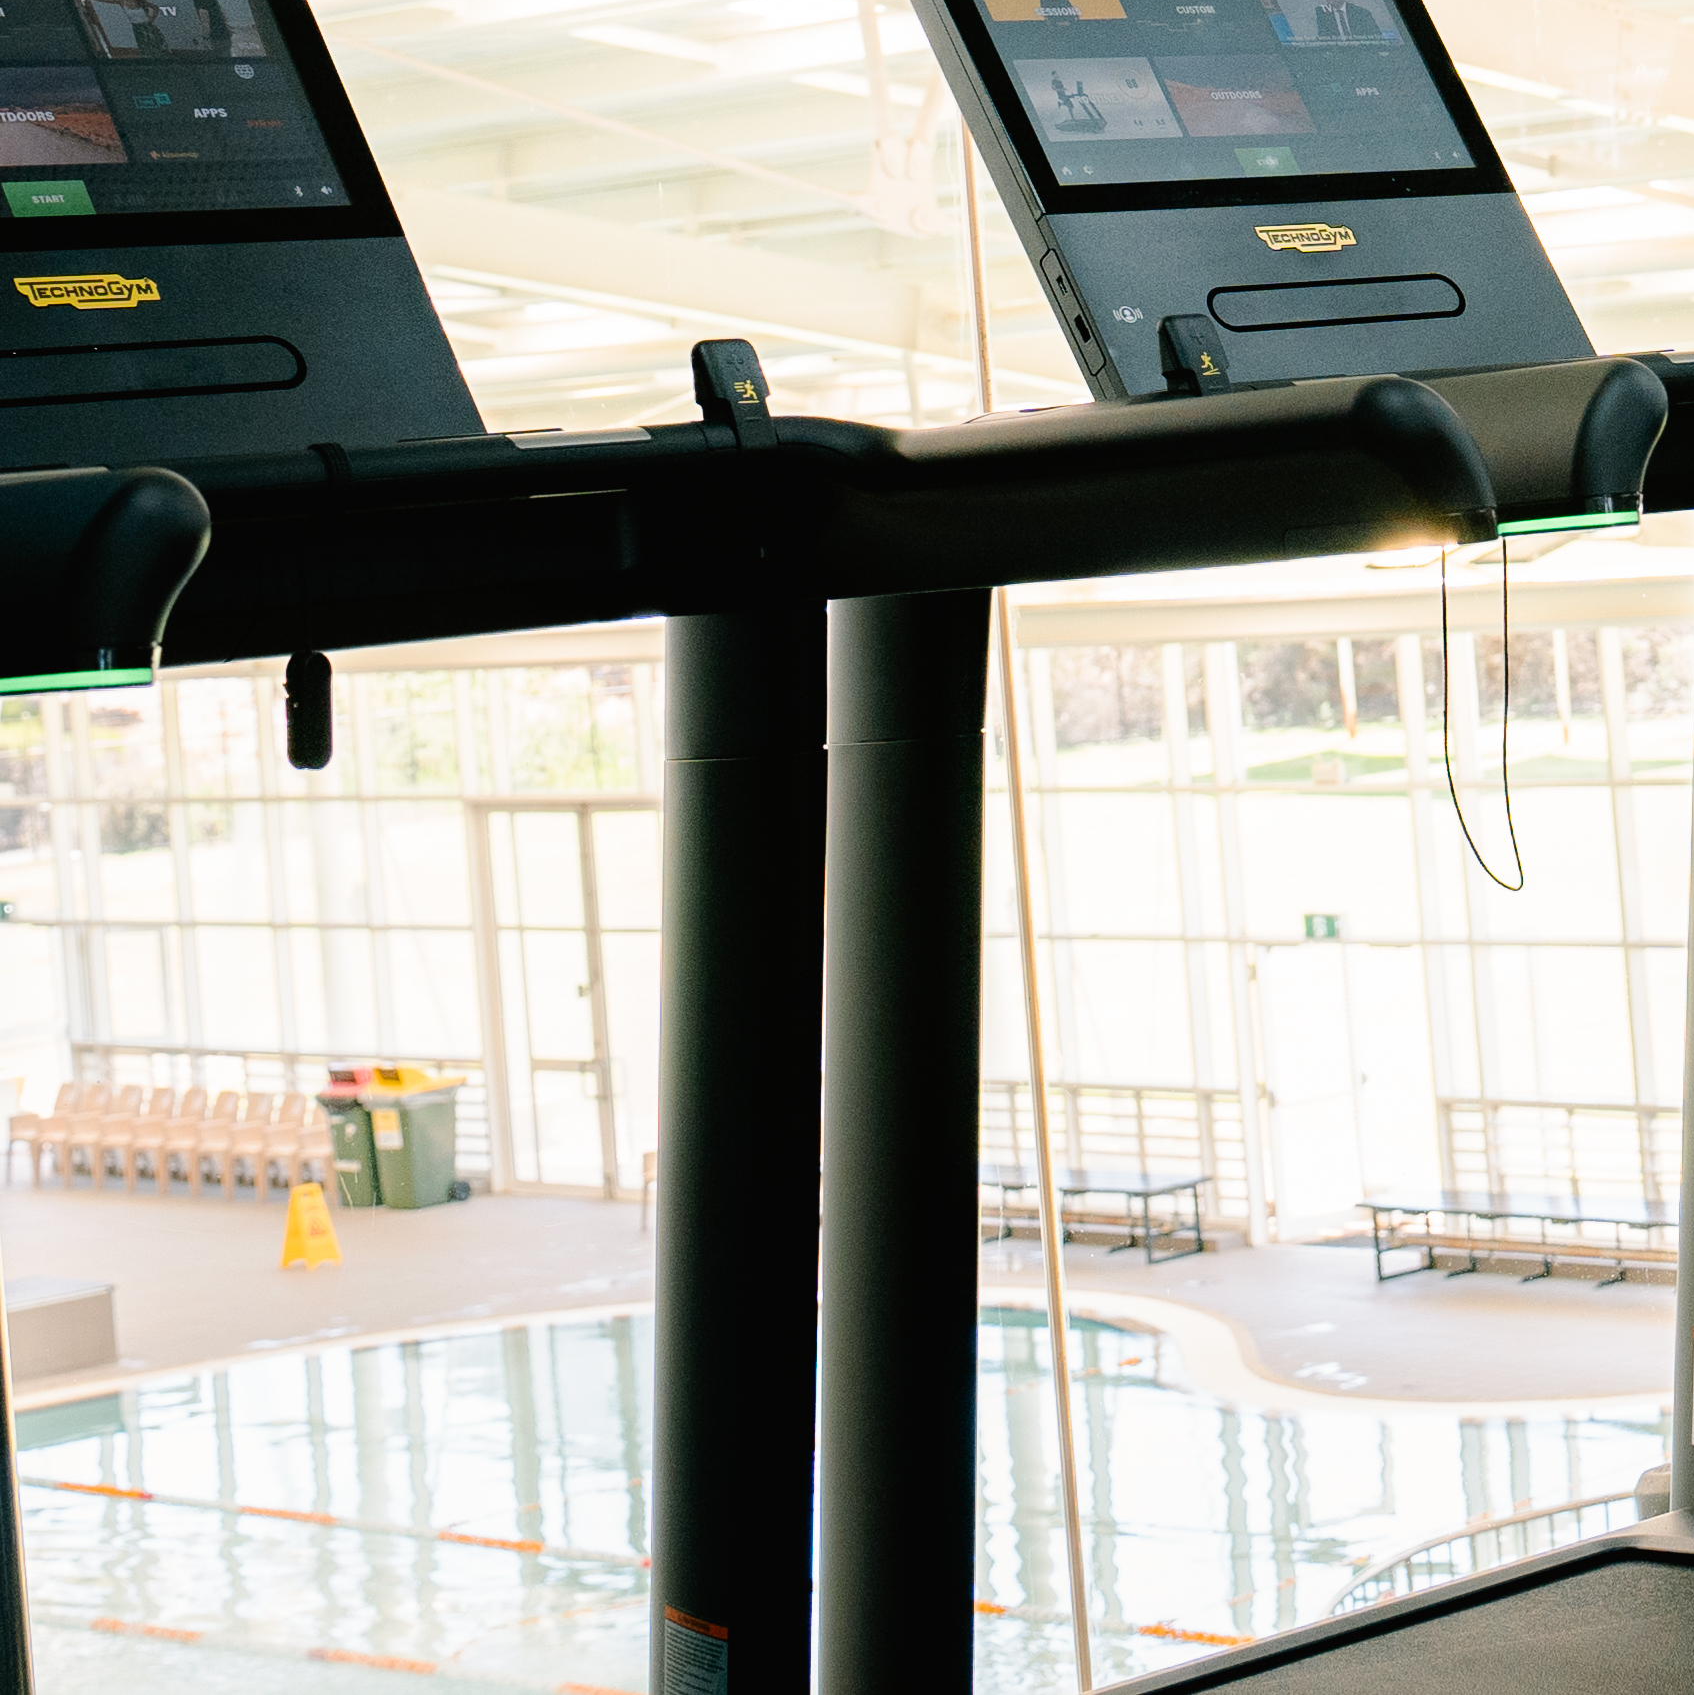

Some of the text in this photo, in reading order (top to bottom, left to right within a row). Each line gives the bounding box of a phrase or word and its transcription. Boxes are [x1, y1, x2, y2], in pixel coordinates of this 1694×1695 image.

[159, 6, 177, 17] TV
[1034, 7, 1082, 16] SESSIONS
[1176, 6, 1216, 14] CUSTOM
[1211, 90, 1262, 101] OUTDOORS
[1355, 87, 1379, 96] APPS
[193, 107, 228, 119] APPS
[31, 194, 65, 204] START
[1259, 227, 1352, 247] TECHNOGYM
[18, 278, 155, 304] TECHNOGYM
